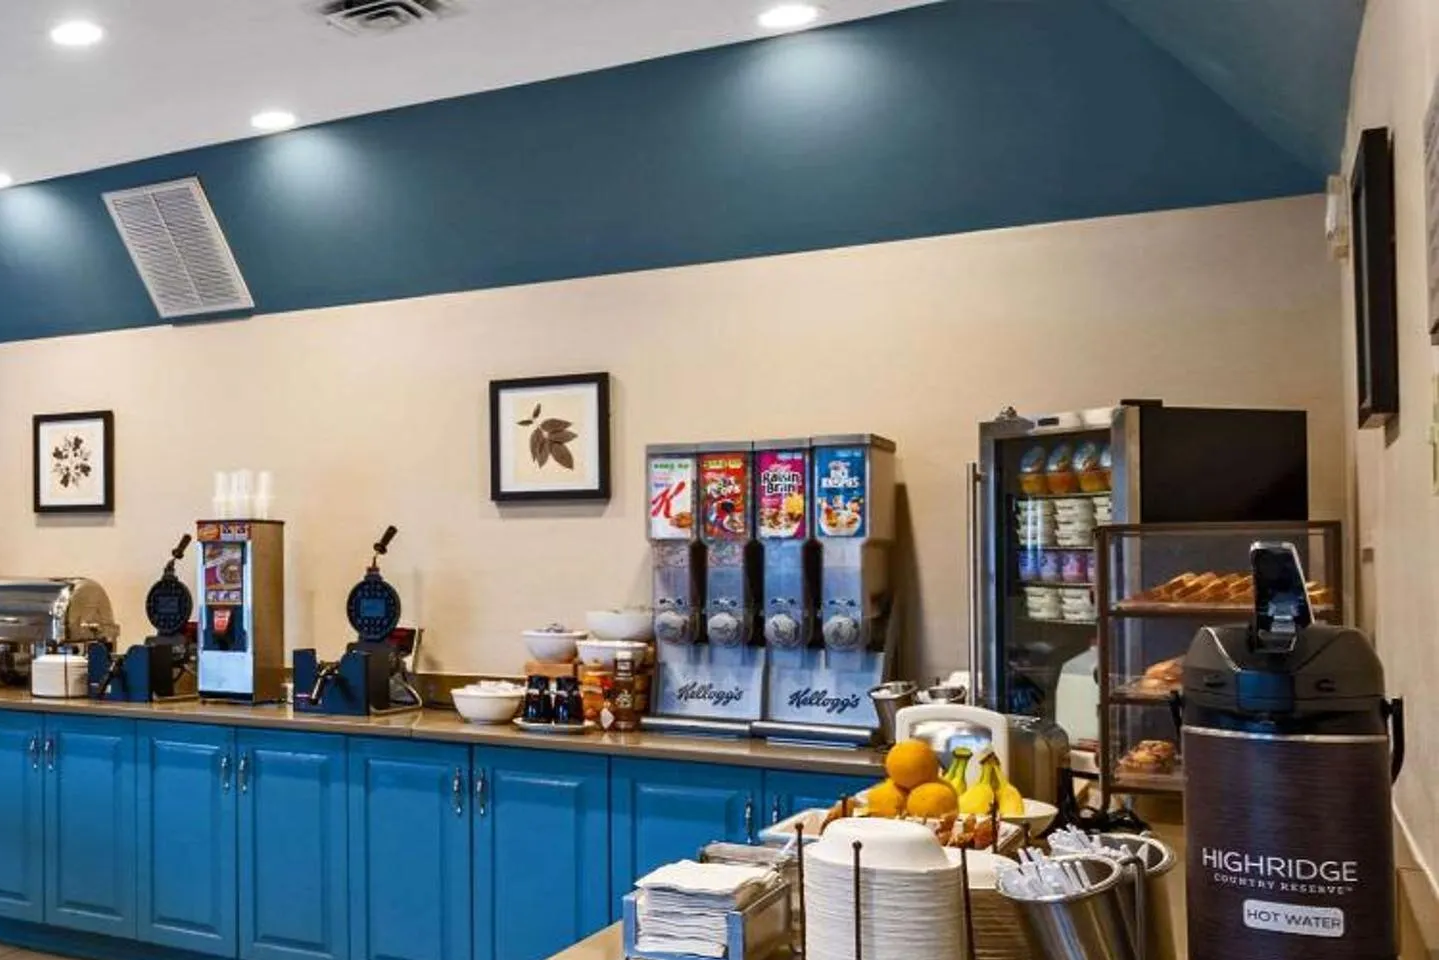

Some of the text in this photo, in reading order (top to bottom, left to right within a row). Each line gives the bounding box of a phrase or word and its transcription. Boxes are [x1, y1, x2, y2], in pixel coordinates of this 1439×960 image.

[762, 470, 801, 485] Raisin
[766, 481, 795, 494] Bran
[677, 681, 744, 706] Kellogg's
[788, 687, 860, 713] Kellogg's
[1201, 847, 1358, 882] HIGHRIDGE
[1213, 872, 1275, 891] COUNTRY
[1246, 908, 1342, 930] HOT WATER
